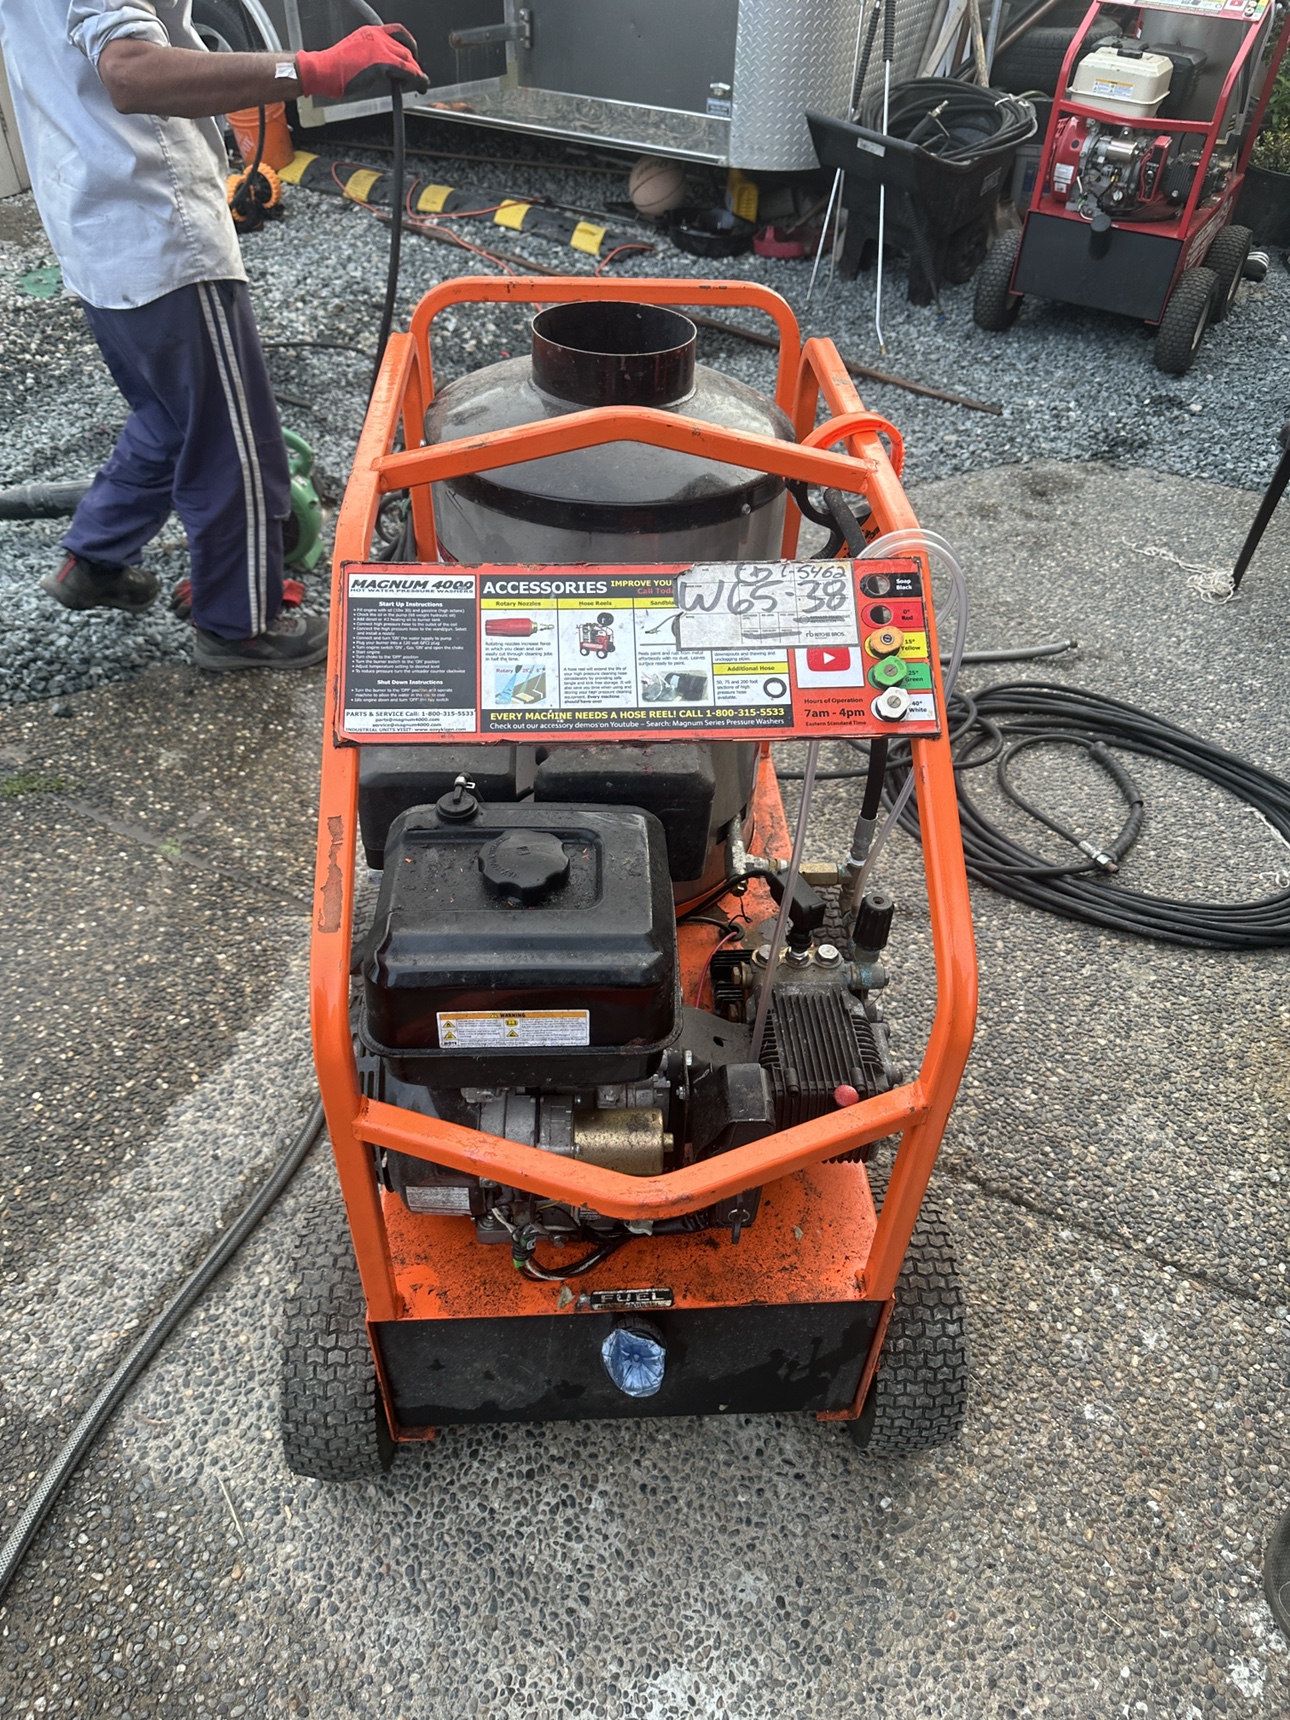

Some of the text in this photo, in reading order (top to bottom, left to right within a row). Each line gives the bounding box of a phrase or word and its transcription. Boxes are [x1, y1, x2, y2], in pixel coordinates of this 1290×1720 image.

[351, 580, 474, 590] MAGNUM 4000
[483, 581, 608, 594] ACCESSORIES
[706, 708, 784, 717] 1-800-315-5533
[840, 709, 865, 718] 4pm
[601, 1292, 664, 1303] FUEL
